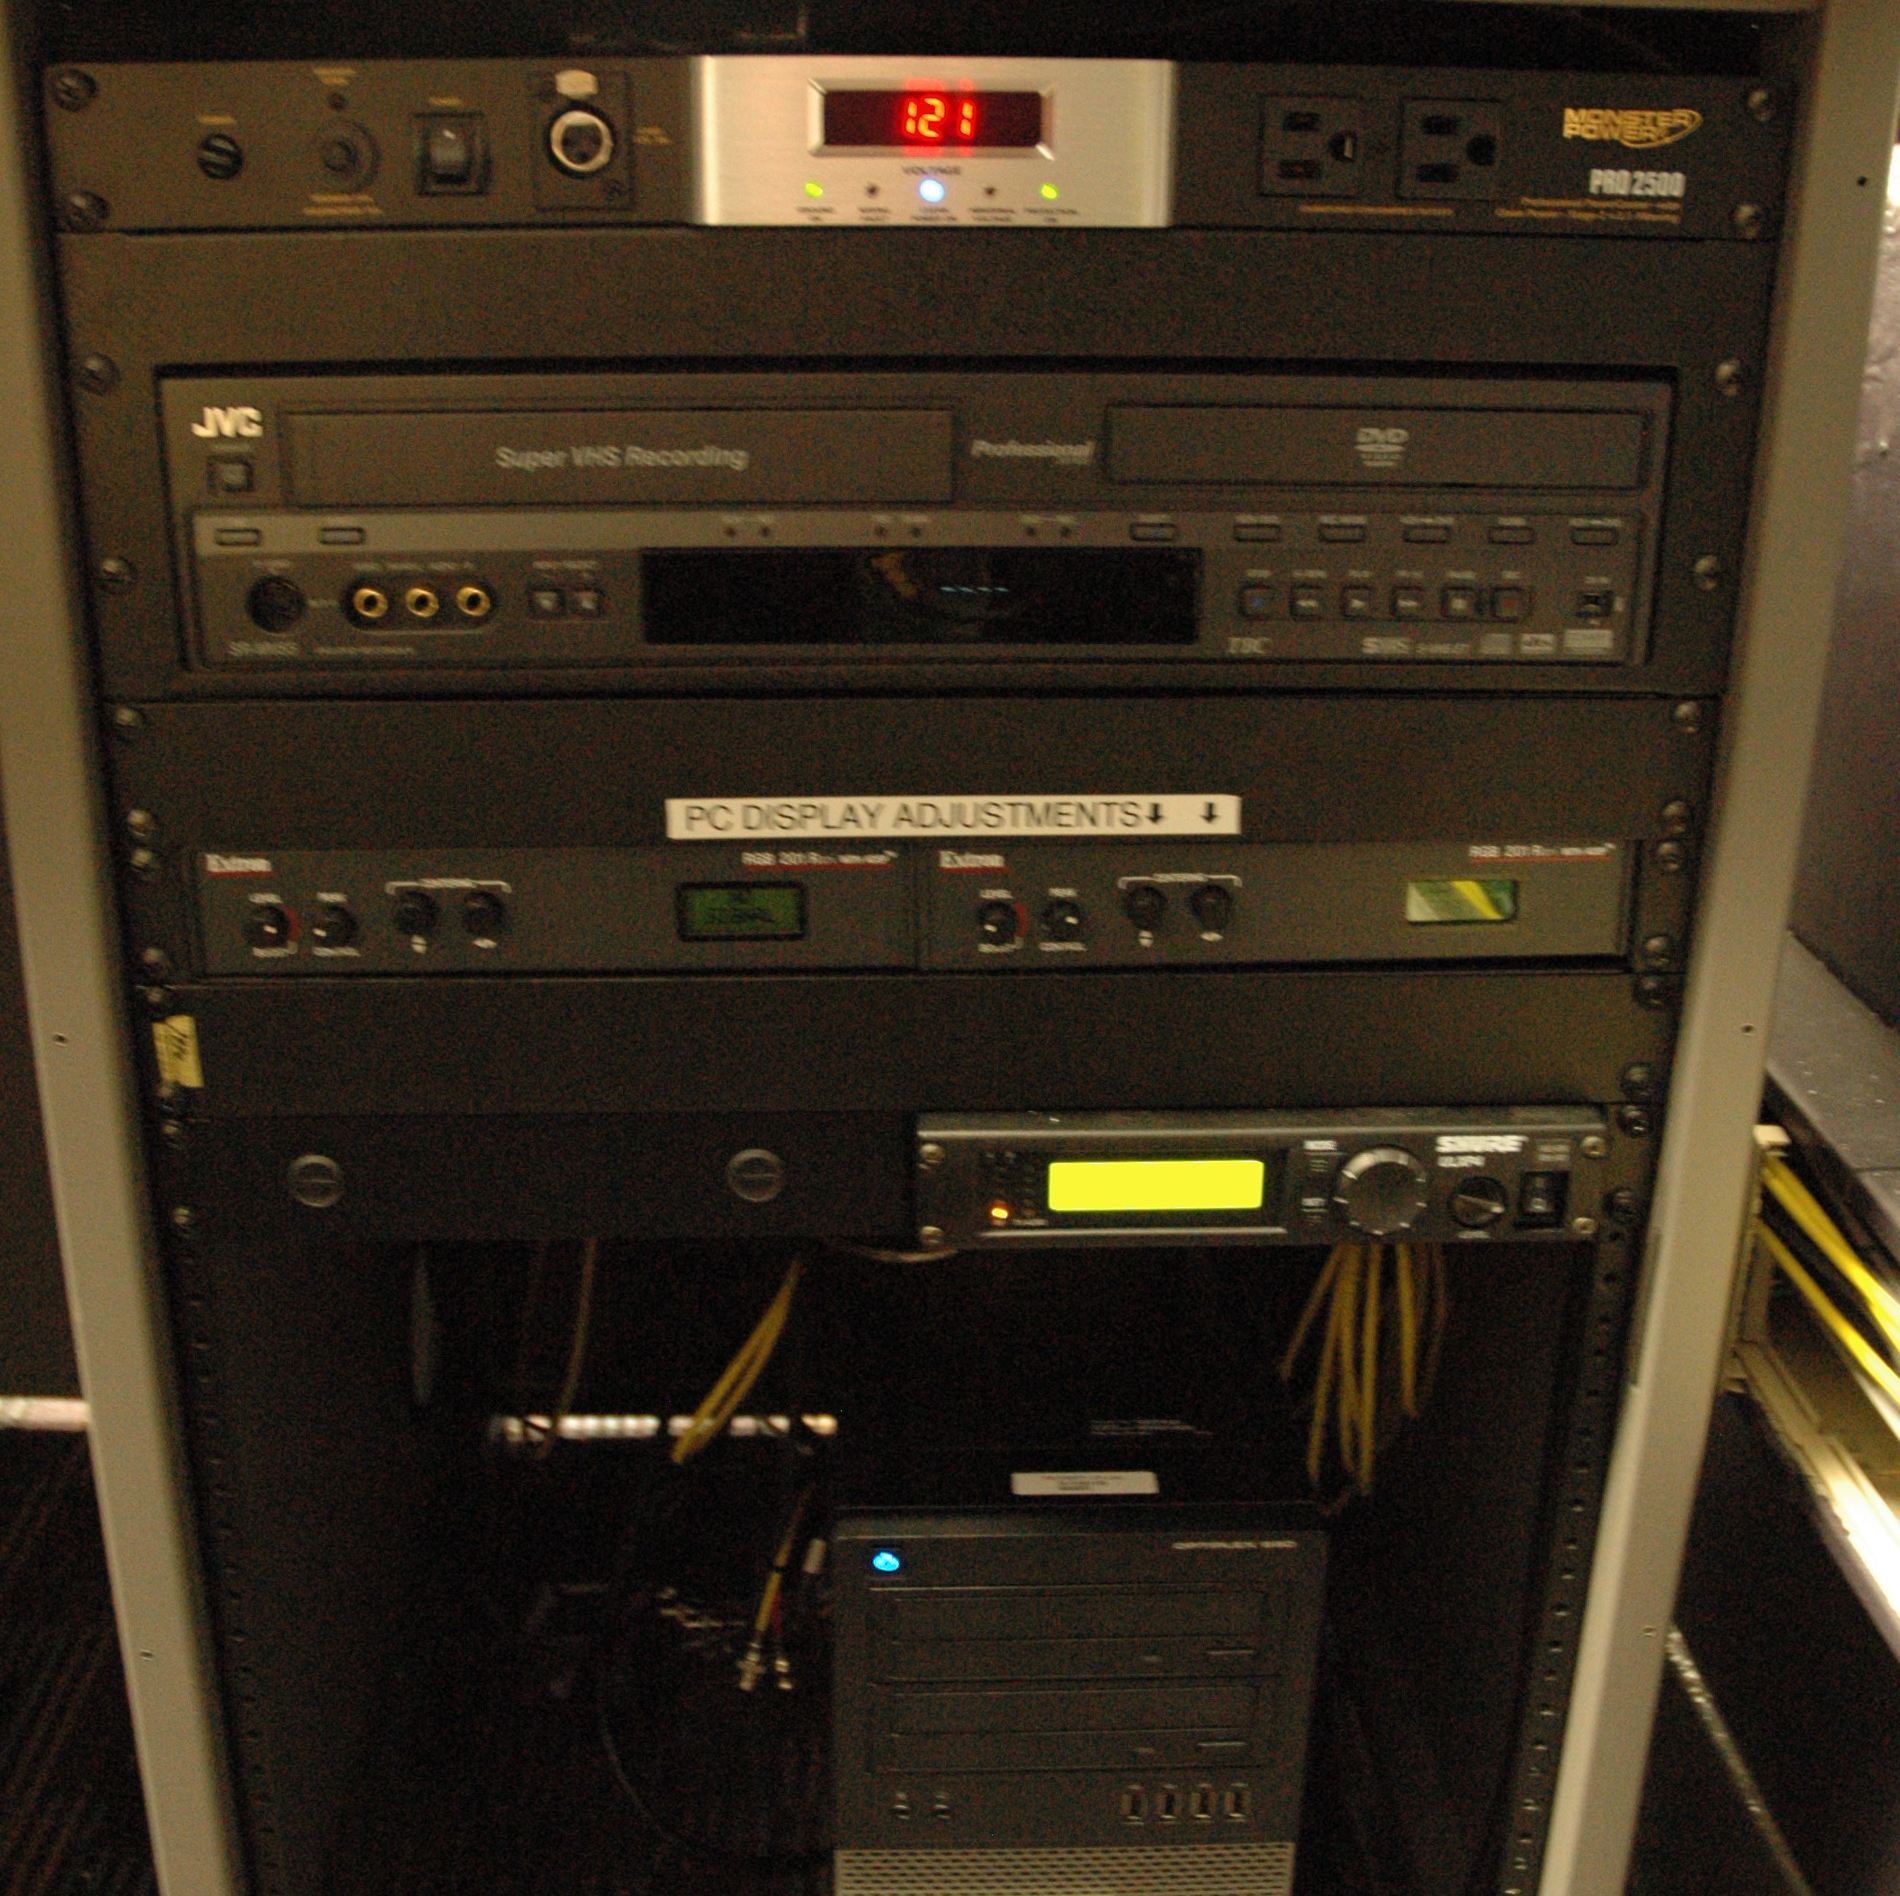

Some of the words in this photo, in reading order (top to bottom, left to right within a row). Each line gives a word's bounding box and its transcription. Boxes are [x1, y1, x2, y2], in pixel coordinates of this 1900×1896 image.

[905, 97, 974, 138] 121
[1563, 108, 1693, 126] MONSTER
[1589, 168, 1632, 195] PRO
[1632, 170, 1687, 197] 2500
[191, 406, 263, 438] JVC
[495, 446, 568, 472] Super
[570, 446, 621, 467] VHS
[624, 445, 748, 471] Recording
[685, 804, 734, 832] PC
[741, 803, 883, 831] DISPLAY
[893, 801, 1143, 830] ADJUSTMENTS
